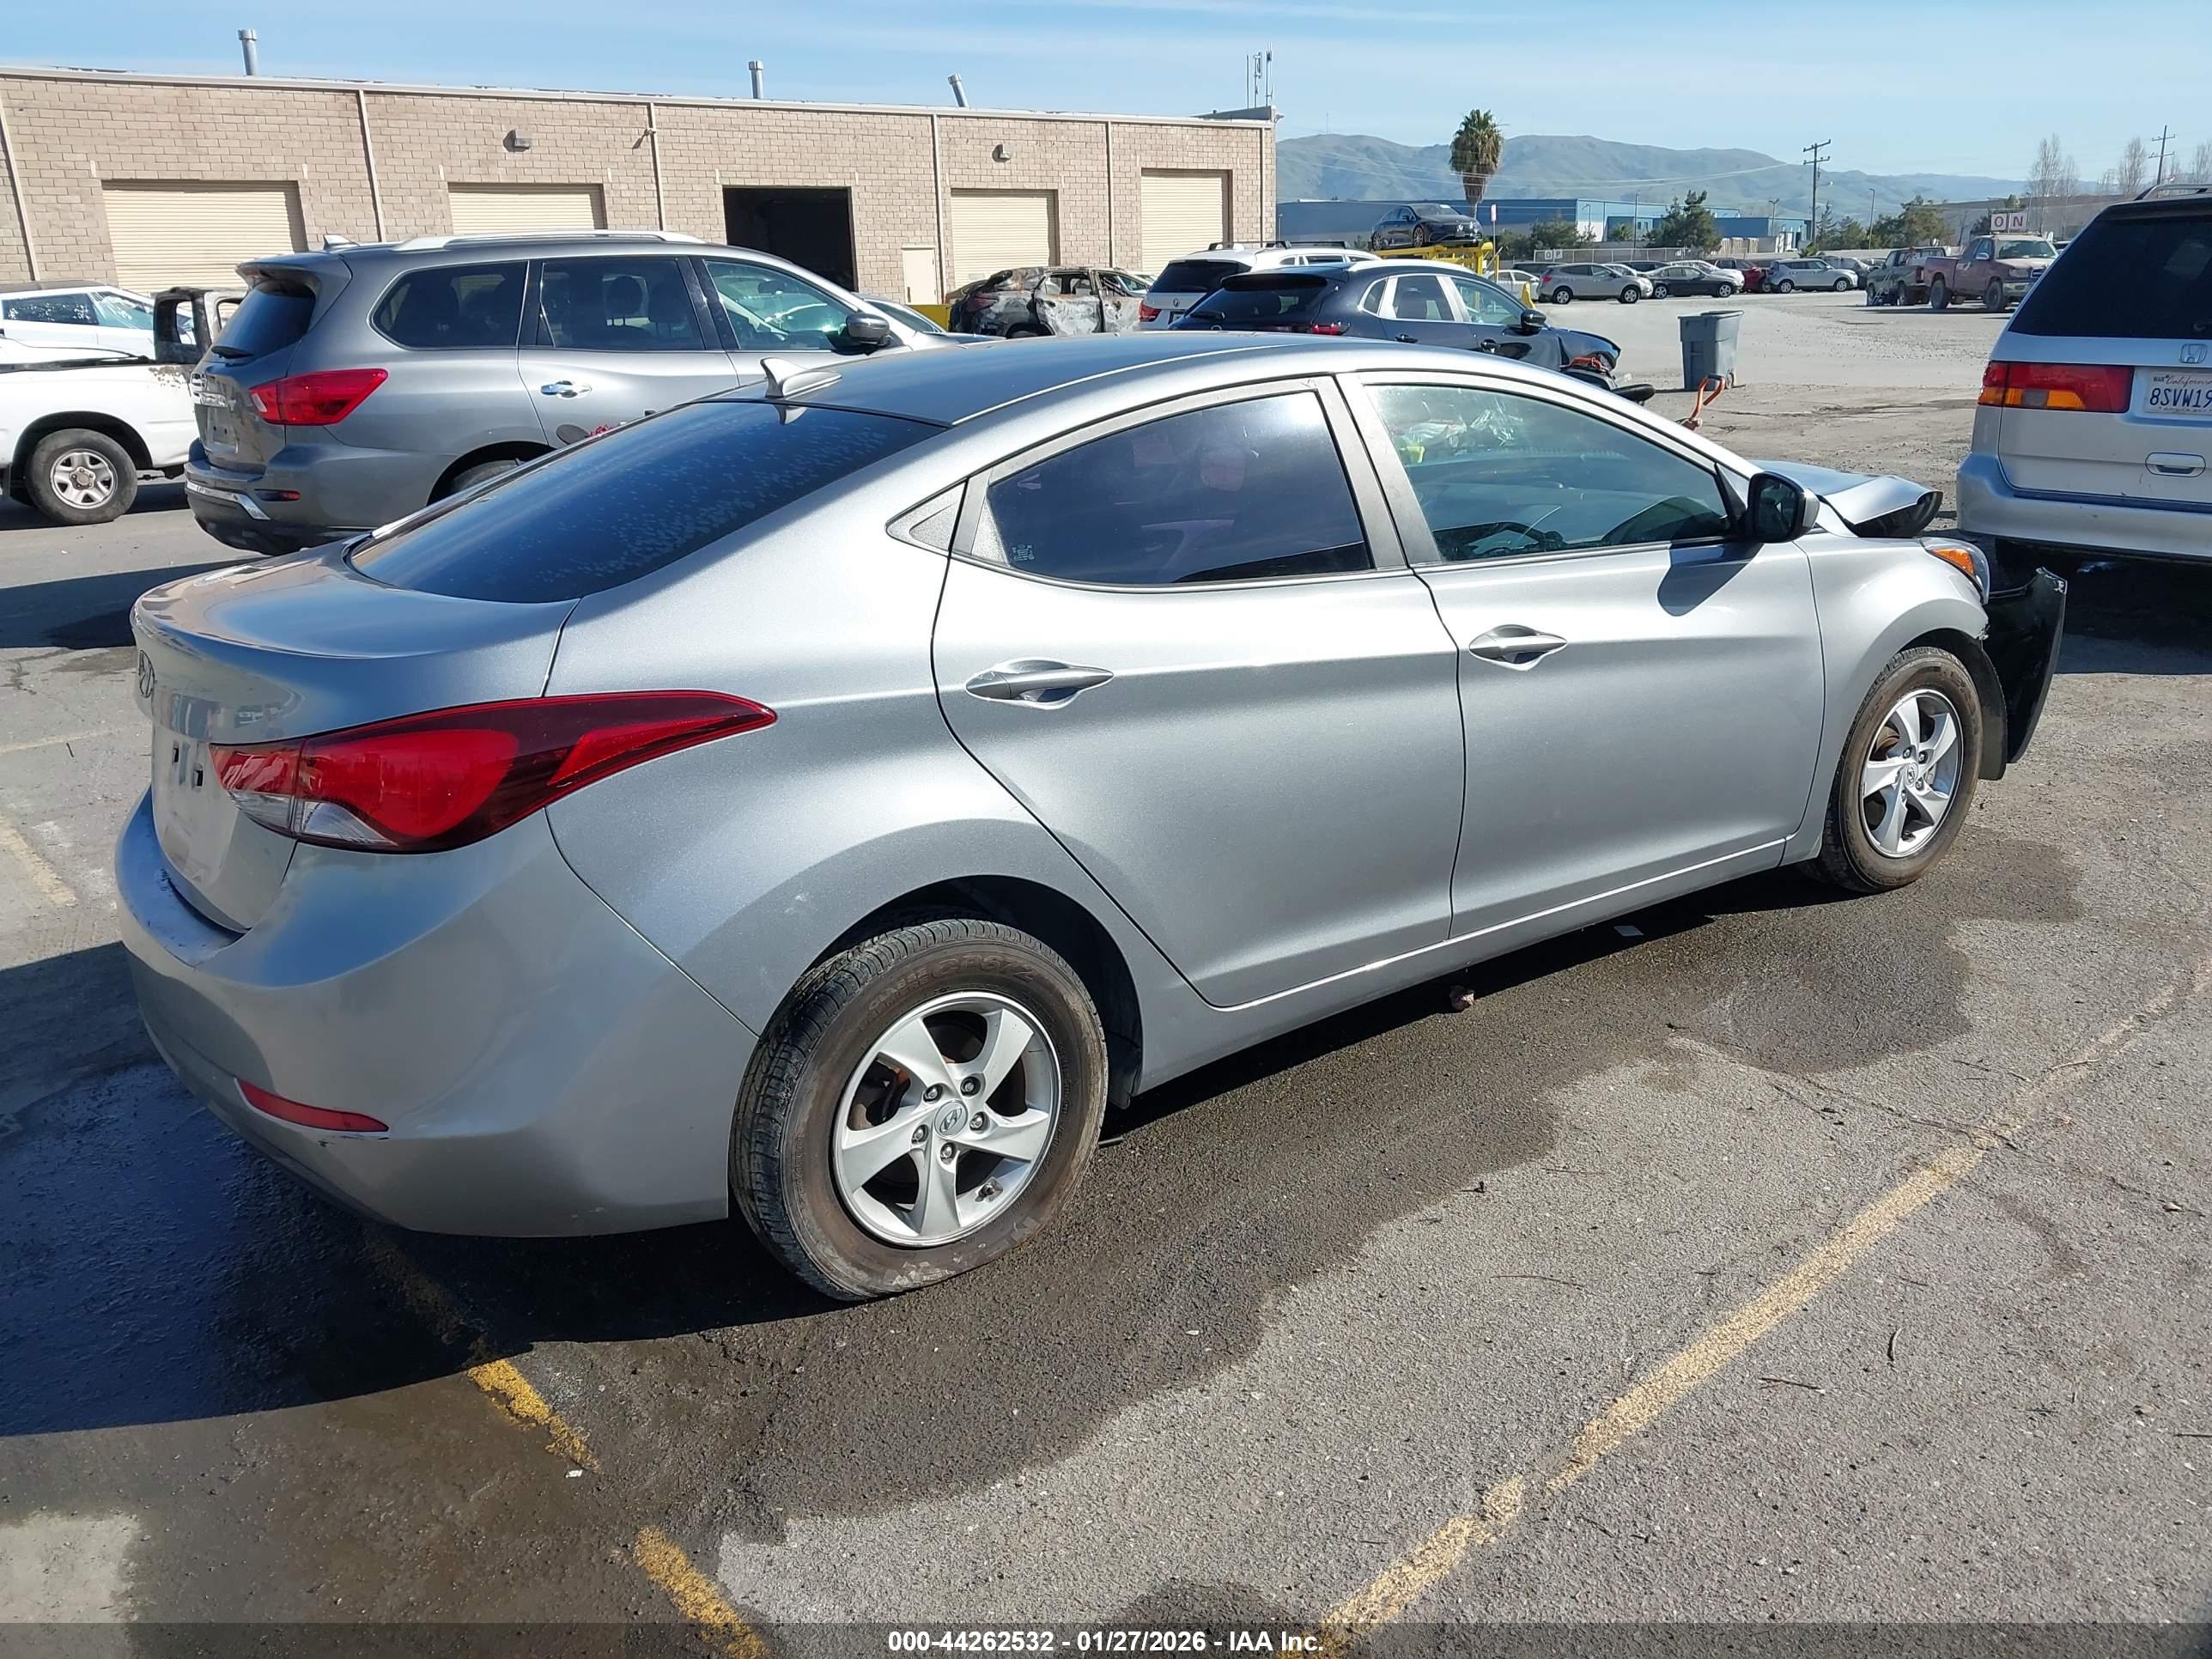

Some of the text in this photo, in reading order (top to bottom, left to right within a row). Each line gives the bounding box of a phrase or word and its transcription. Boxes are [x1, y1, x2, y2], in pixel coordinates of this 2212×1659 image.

[1994, 216, 2023, 228] O N
[2149, 387, 2212, 409] 8SVW19
